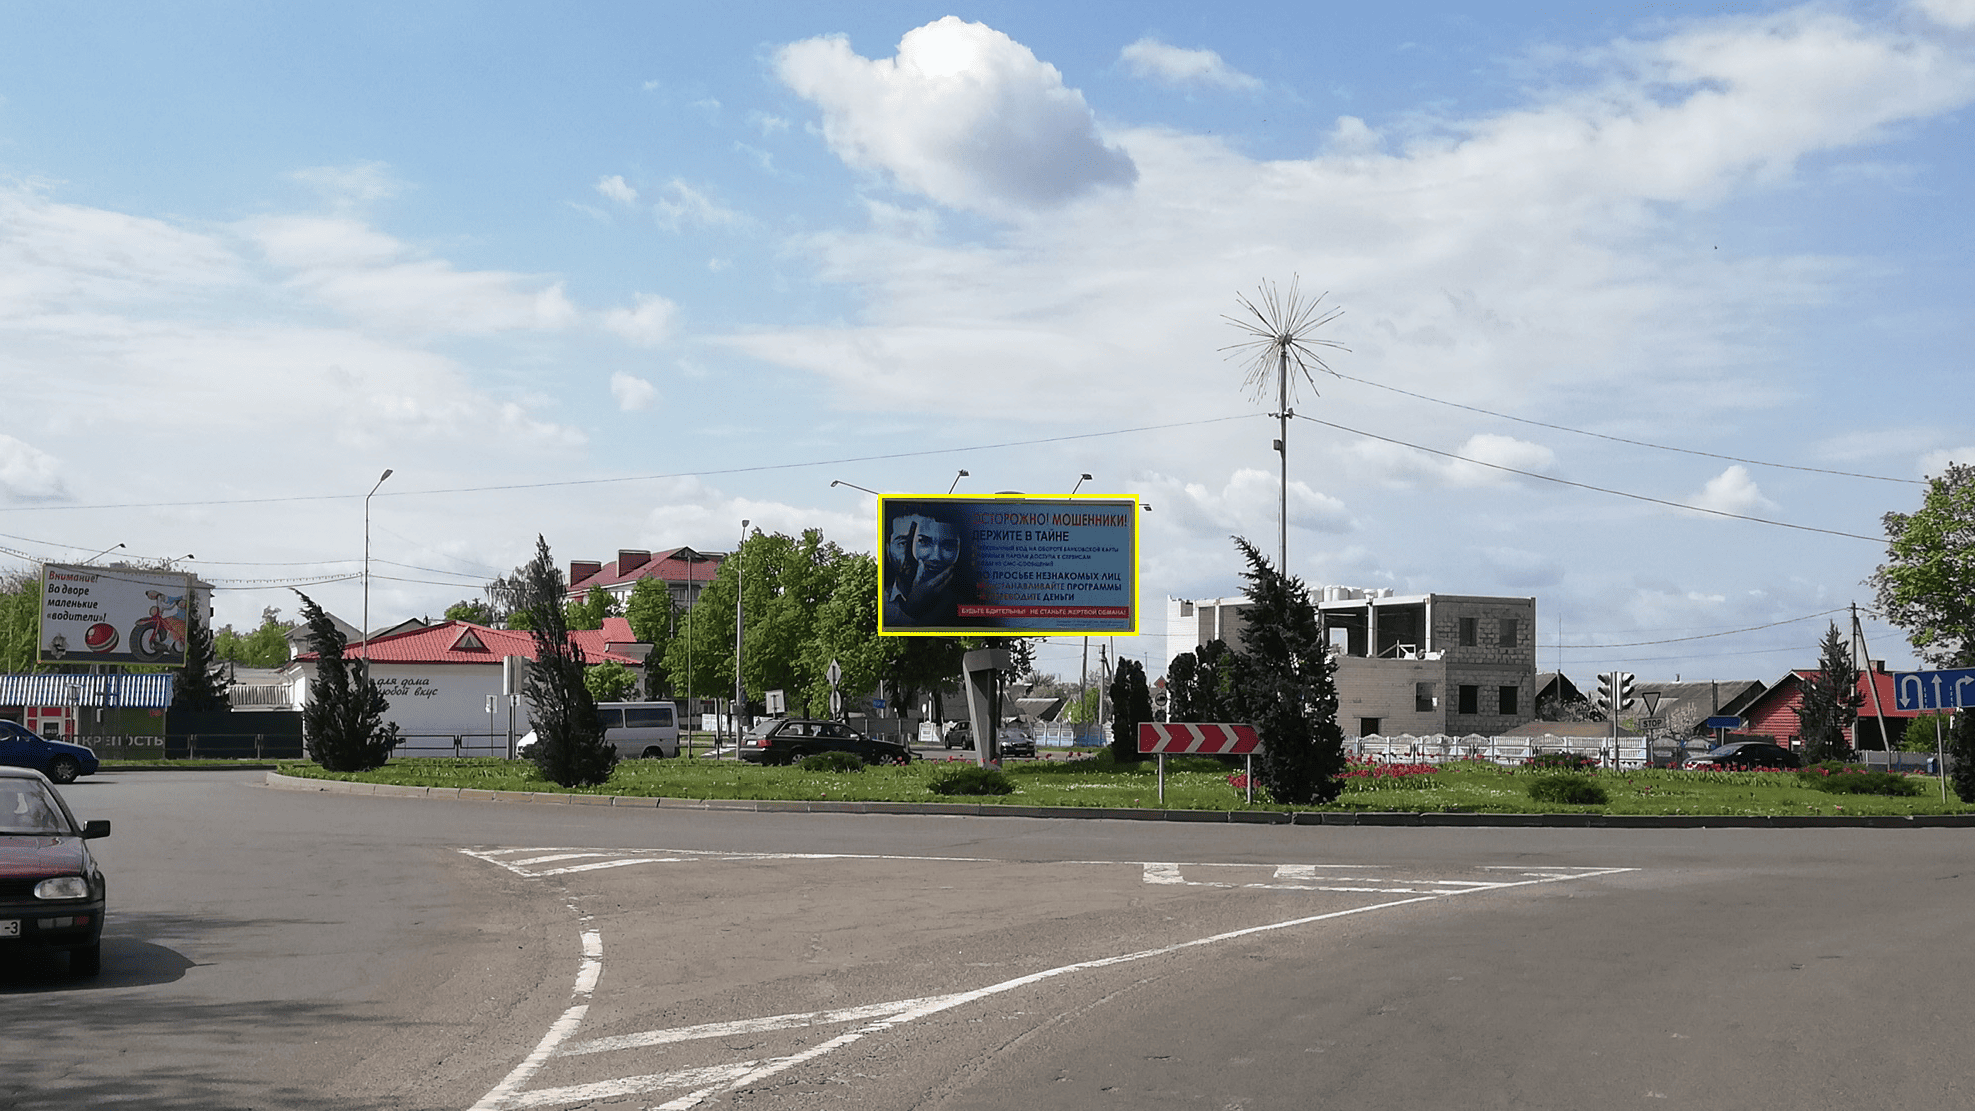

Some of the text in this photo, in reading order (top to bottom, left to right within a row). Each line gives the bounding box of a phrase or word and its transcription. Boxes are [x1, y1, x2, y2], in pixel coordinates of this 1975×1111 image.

[1053, 513, 1127, 527] МОШЕННИКИ!
[973, 529, 1069, 541] ДЕРЖИТЕ В ТАЙНЕ
[48, 570, 99, 583] Внимание!
[1036, 572, 1099, 580] НЕЗНАКОМЫХ
[1101, 573, 1121, 581] ЛИЦ
[48, 583, 90, 597] Во дворе
[1067, 583, 1122, 591] ПРОГРАММЫ
[1043, 593, 1075, 601] ДЕНЬГИ
[47, 599, 98, 609] маленькие
[46, 610, 107, 622] «водители»!
[377, 678, 430, 688] для дома
[414, 686, 438, 699] вкус
[1643, 720, 1662, 728] STOP
